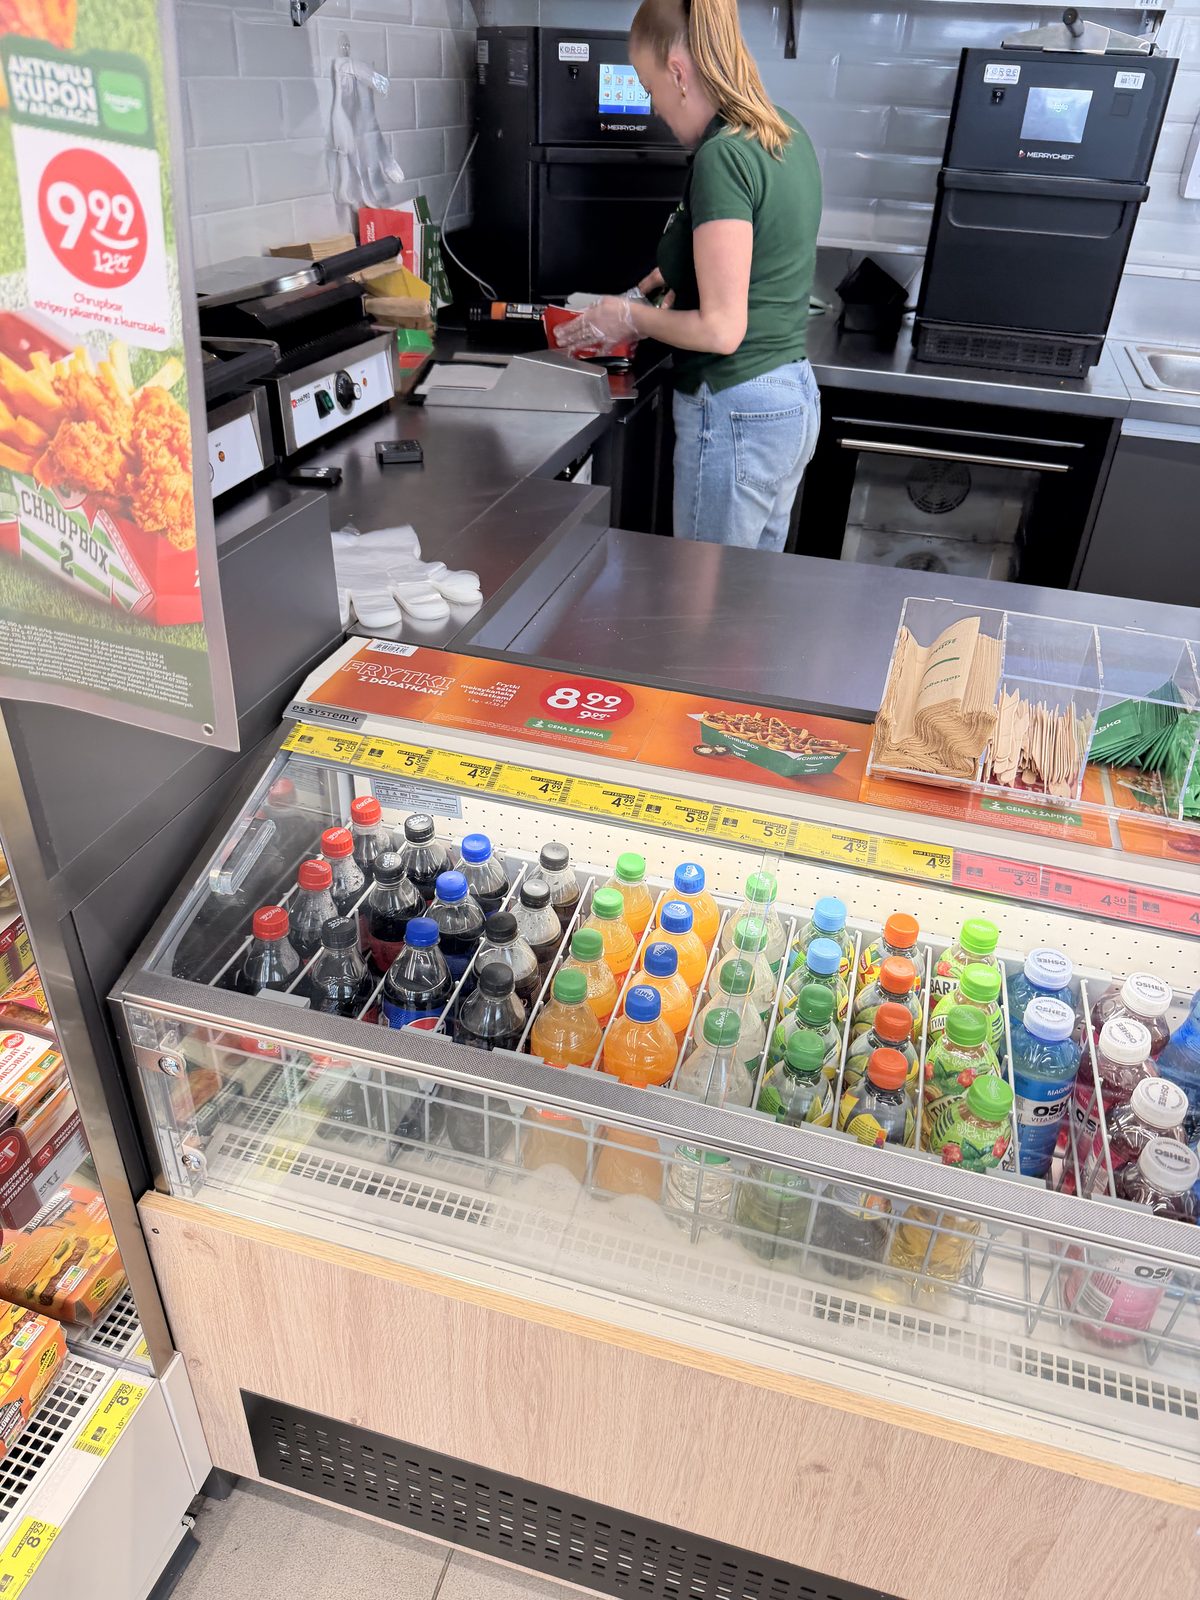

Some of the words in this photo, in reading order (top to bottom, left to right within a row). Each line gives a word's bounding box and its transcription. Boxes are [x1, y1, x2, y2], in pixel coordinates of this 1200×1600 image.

[10, 73, 98, 111] KUPON
[606, 123, 648, 132] MERRYCHEF
[1026, 150, 1075, 161] MERRYCHEF
[120, 316, 166, 336] kurczaka
[341, 659, 455, 690] FRYTKI
[367, 677, 449, 697] DODATKAMI
[496, 681, 521, 690] Frytki
[547, 687, 581, 709] 8
[547, 723, 568, 732] CENA
[1136, 980, 1166, 993] OSHEE
[1033, 1100, 1070, 1118] OSH
[1155, 1147, 1191, 1166] OSHEE
[116, 1396, 129, 1406] 8
[27, 1535, 41, 1549] 8
